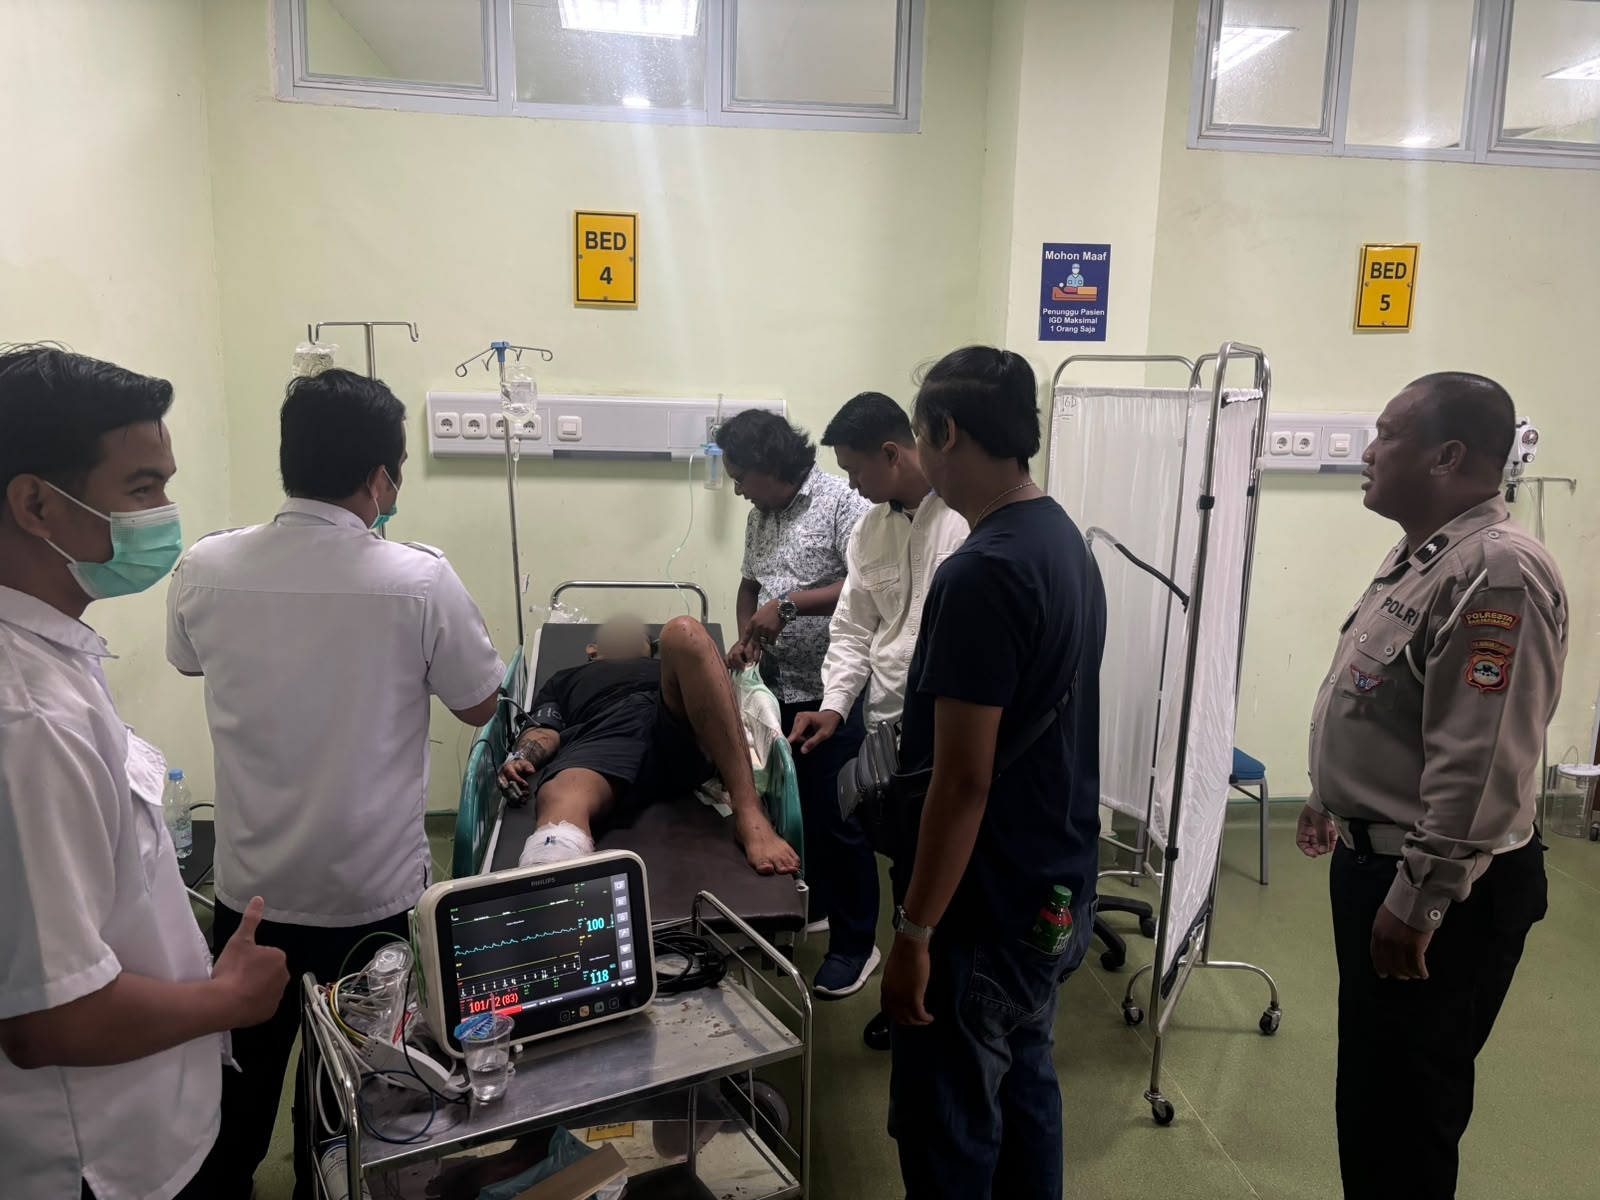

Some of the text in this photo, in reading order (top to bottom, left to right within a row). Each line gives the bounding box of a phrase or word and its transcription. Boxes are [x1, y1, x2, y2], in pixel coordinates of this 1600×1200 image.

[585, 230, 627, 251] BED
[1045, 250, 1107, 261] Mohon Maaf
[599, 266, 613, 285] 4
[1370, 261, 1407, 280] BED
[1379, 294, 1391, 311] 5
[1042, 308, 1105, 316] Penunggu Pasien
[1048, 316, 1098, 324] IGD Maksimal
[1056, 325, 1078, 333] Orang
[1080, 325, 1096, 333] Saja
[1380, 596, 1420, 626] POLRI
[1465, 611, 1514, 623] POLRESTA
[586, 917, 605, 932] 100
[590, 969, 609, 985] 118
[469, 995, 501, 1014] 101/2
